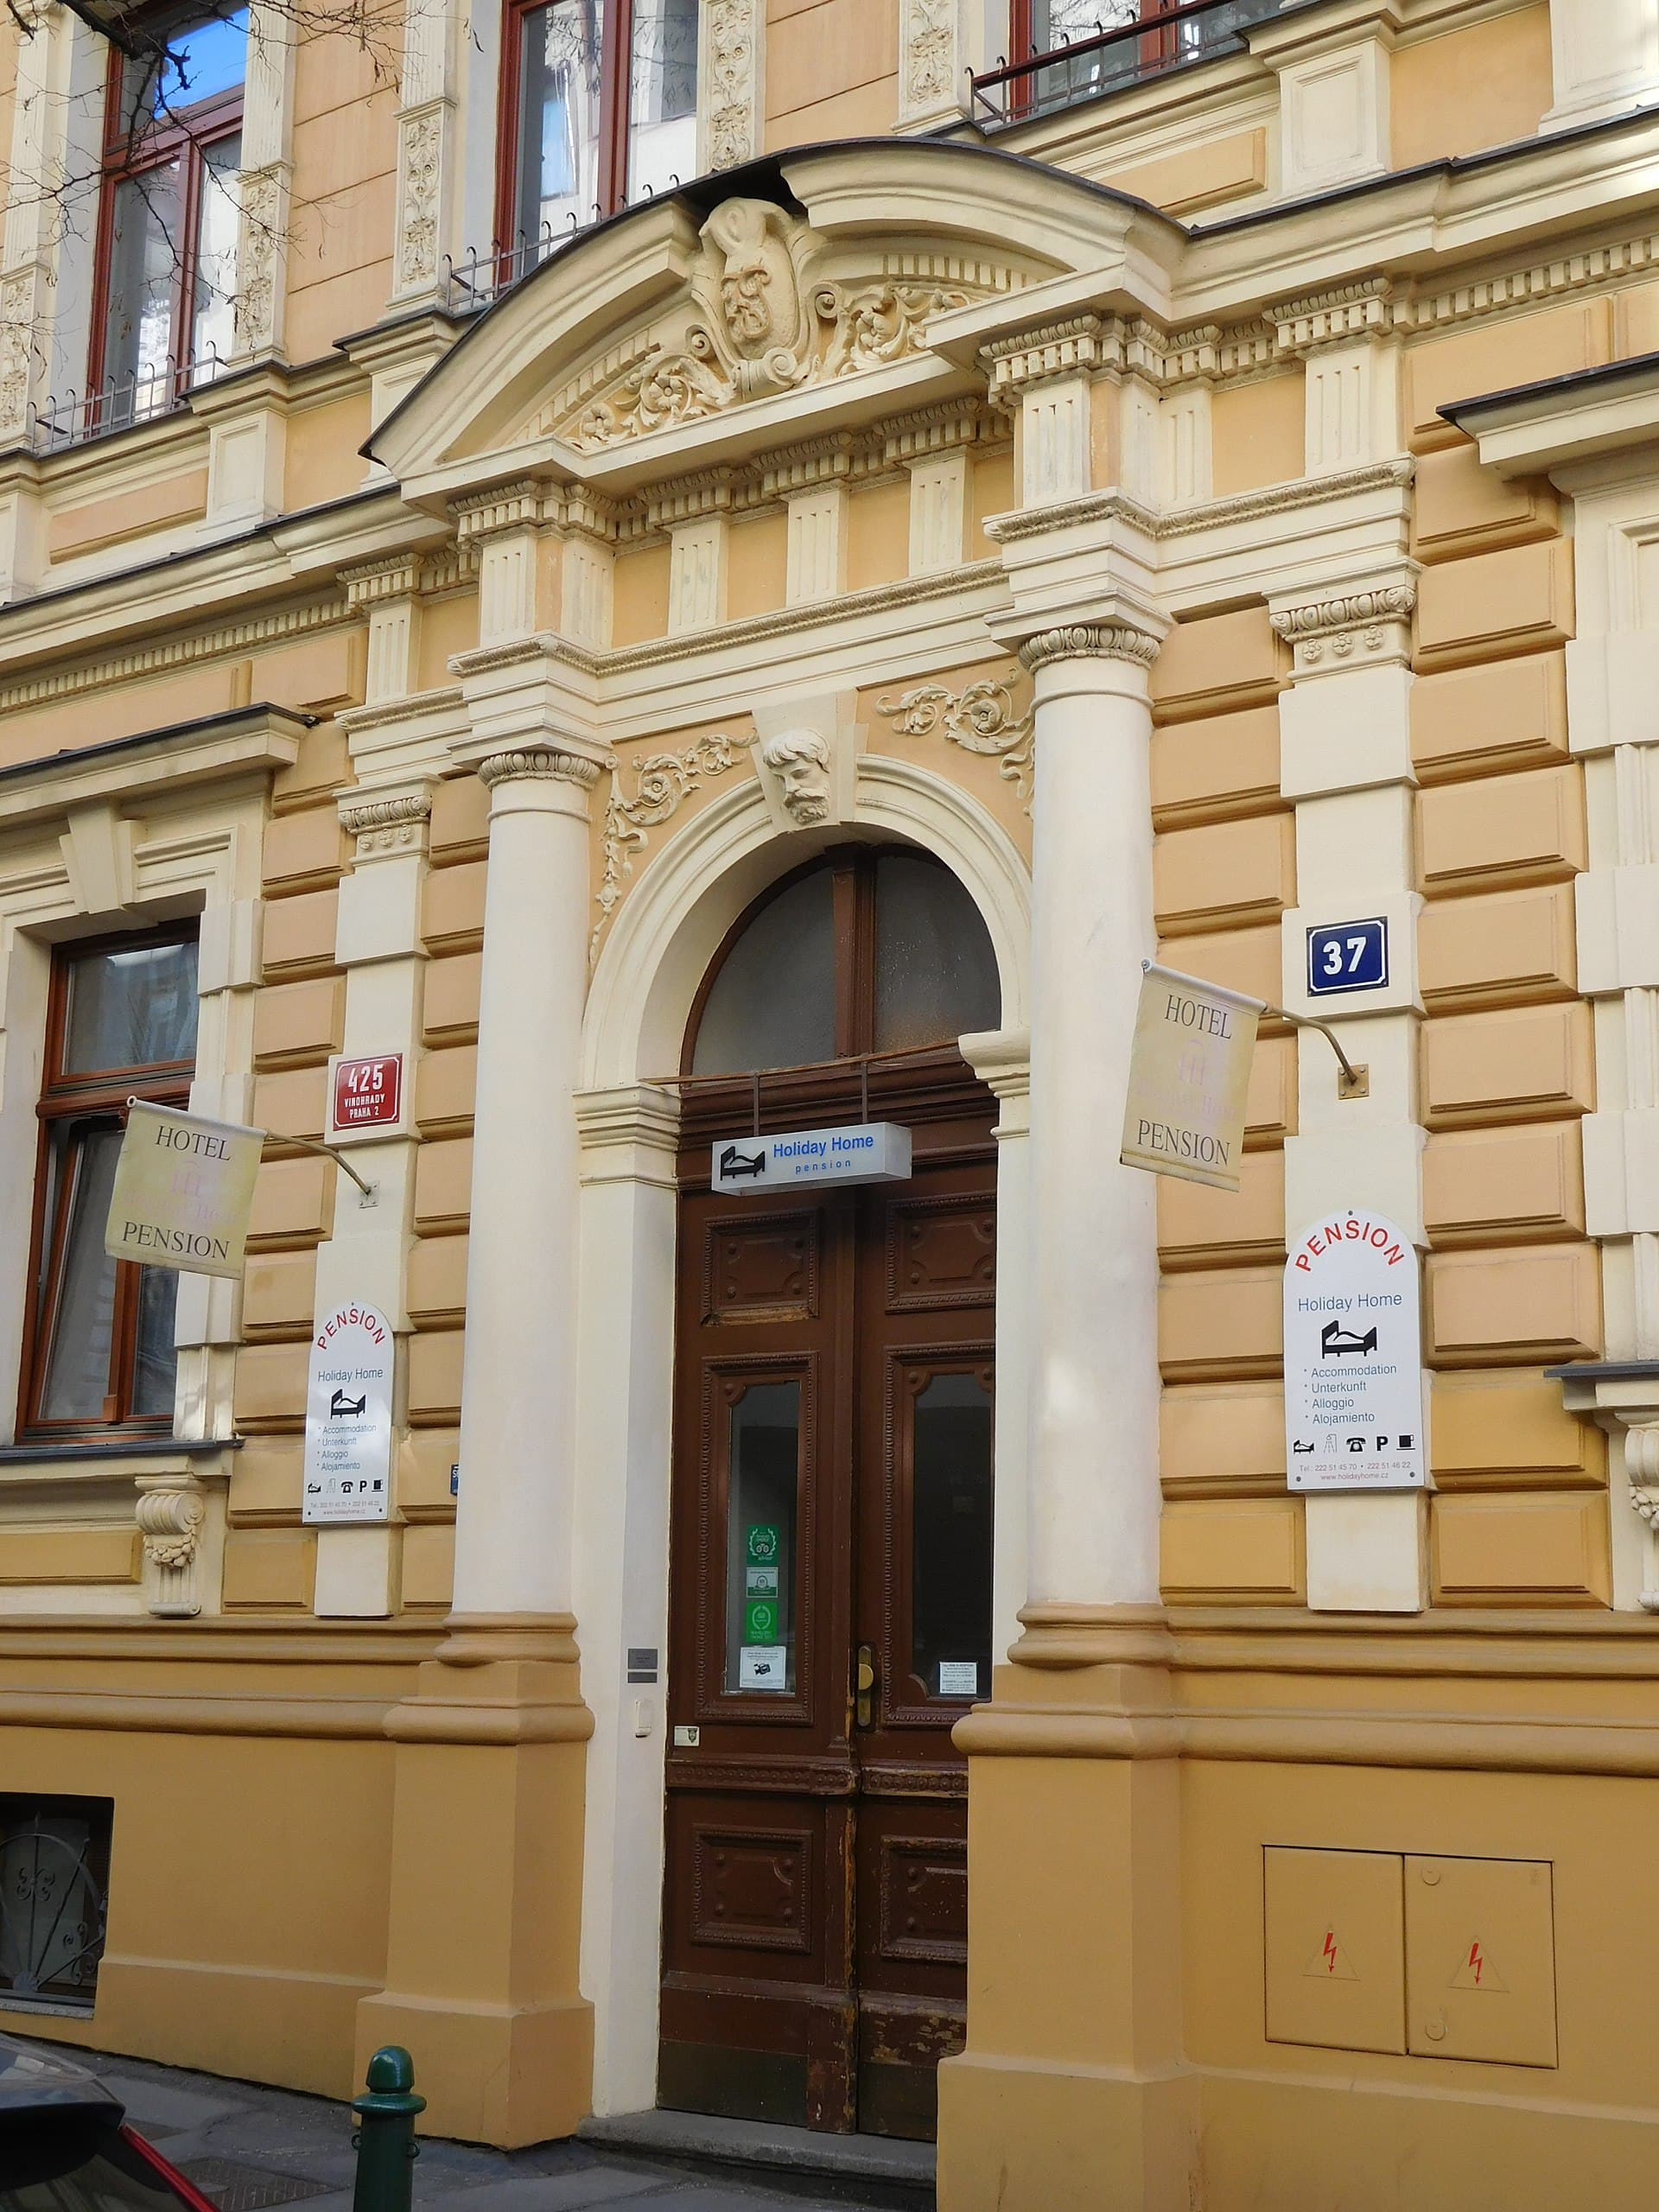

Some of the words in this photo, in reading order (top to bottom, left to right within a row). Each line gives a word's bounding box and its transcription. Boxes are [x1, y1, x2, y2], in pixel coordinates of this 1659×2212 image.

[1322, 937, 1367, 976] 37
[1164, 995, 1231, 1039] HOTEL
[347, 1064, 384, 1093] 425
[344, 1093, 386, 1108] VINOHRADY
[349, 1107, 372, 1119] PRAHA
[374, 1106, 379, 1116] 2
[155, 1125, 232, 1161] HOTEL
[773, 1141, 826, 1158] Holiday
[831, 1135, 874, 1151] Home
[1136, 1119, 1231, 1166] PENSION
[795, 1159, 851, 1174] pension
[121, 1221, 231, 1260] PENSION
[1295, 1219, 1405, 1272] PENSION
[1298, 1295, 1352, 1313] Holiday
[1357, 1294, 1402, 1308] Home
[317, 1308, 385, 1350] PENSION
[318, 1370, 353, 1382] Holiday
[355, 1368, 384, 1380] Home
[1311, 1364, 1397, 1378] Accommodation
[1312, 1382, 1367, 1393] Unterkunft
[1312, 1397, 1354, 1410] Alloggio
[1313, 1412, 1376, 1426] Alojamiento
[1376, 1436, 1389, 1451] P
[359, 1480, 367, 1493] P
